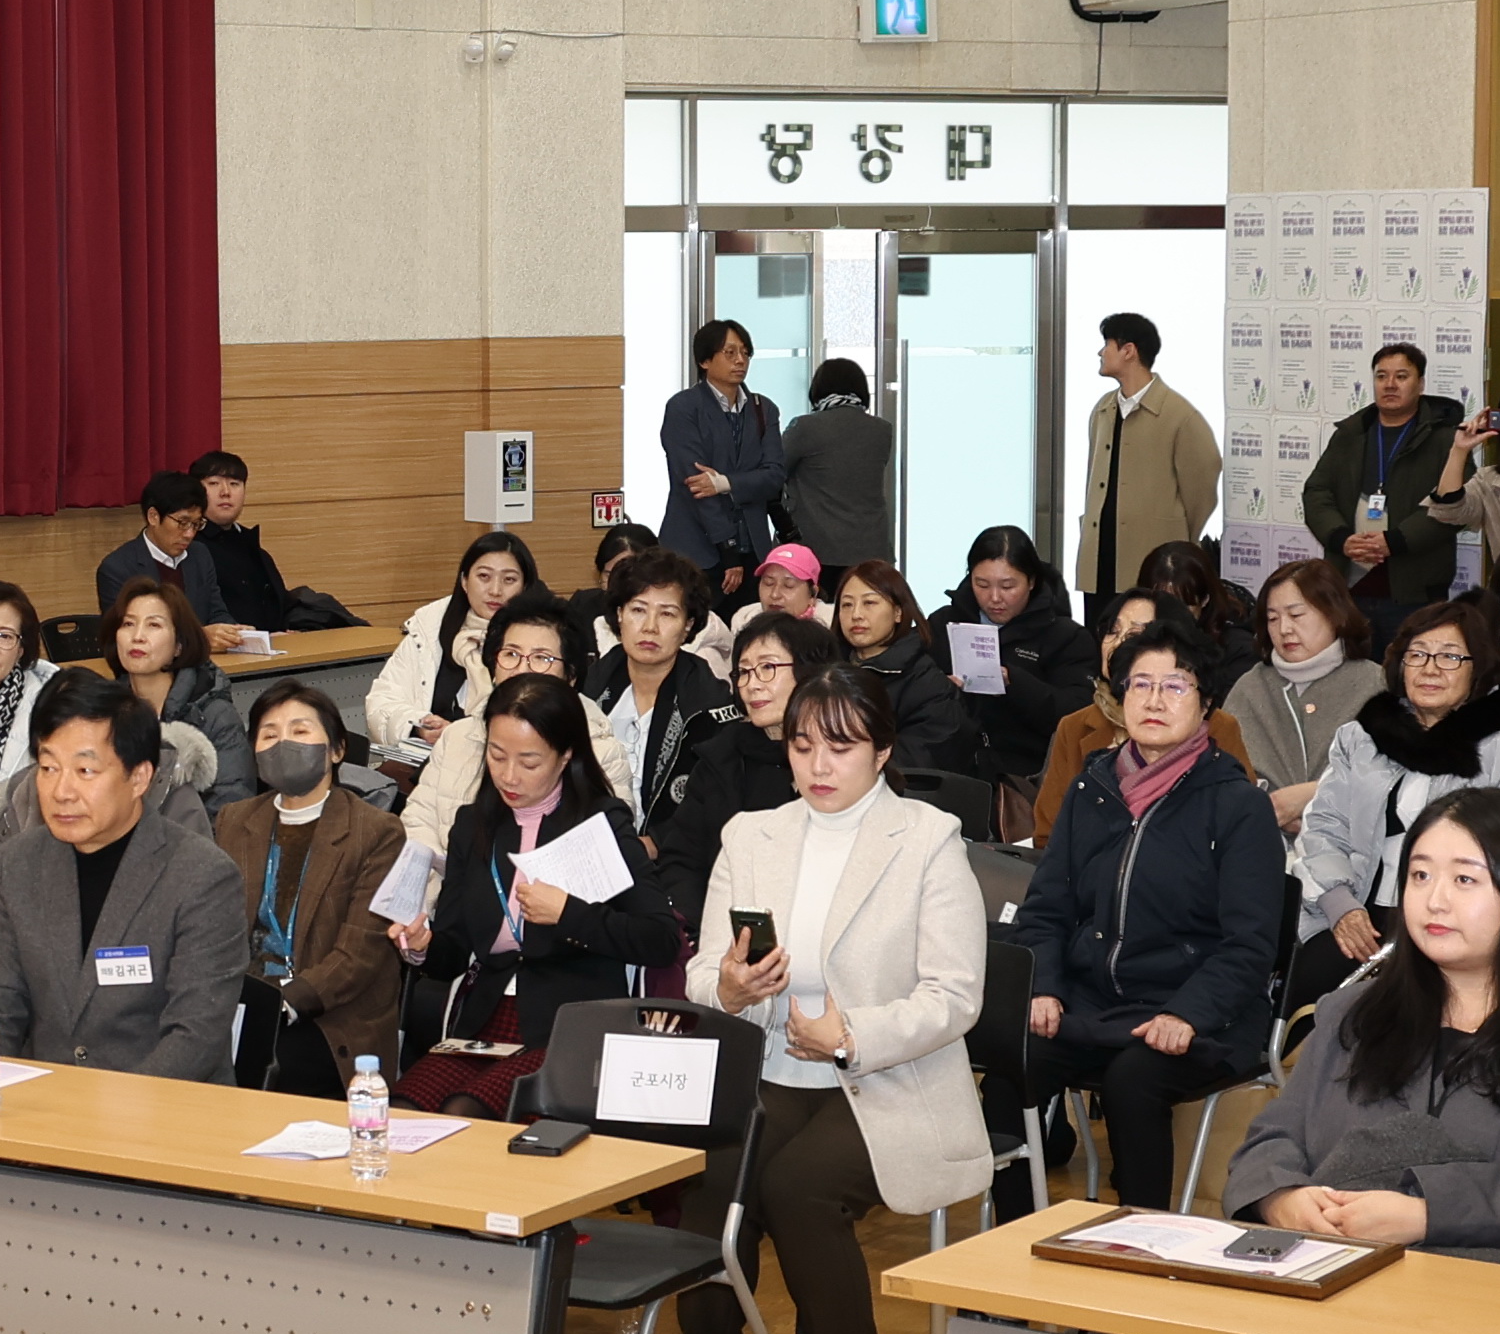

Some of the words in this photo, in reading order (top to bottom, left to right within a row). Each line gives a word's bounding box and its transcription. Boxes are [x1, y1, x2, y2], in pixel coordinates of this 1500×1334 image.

[709, 704, 744, 723] TRO
[116, 964, 148, 977] 김귀근
[630, 1071, 688, 1091] 군포시장
